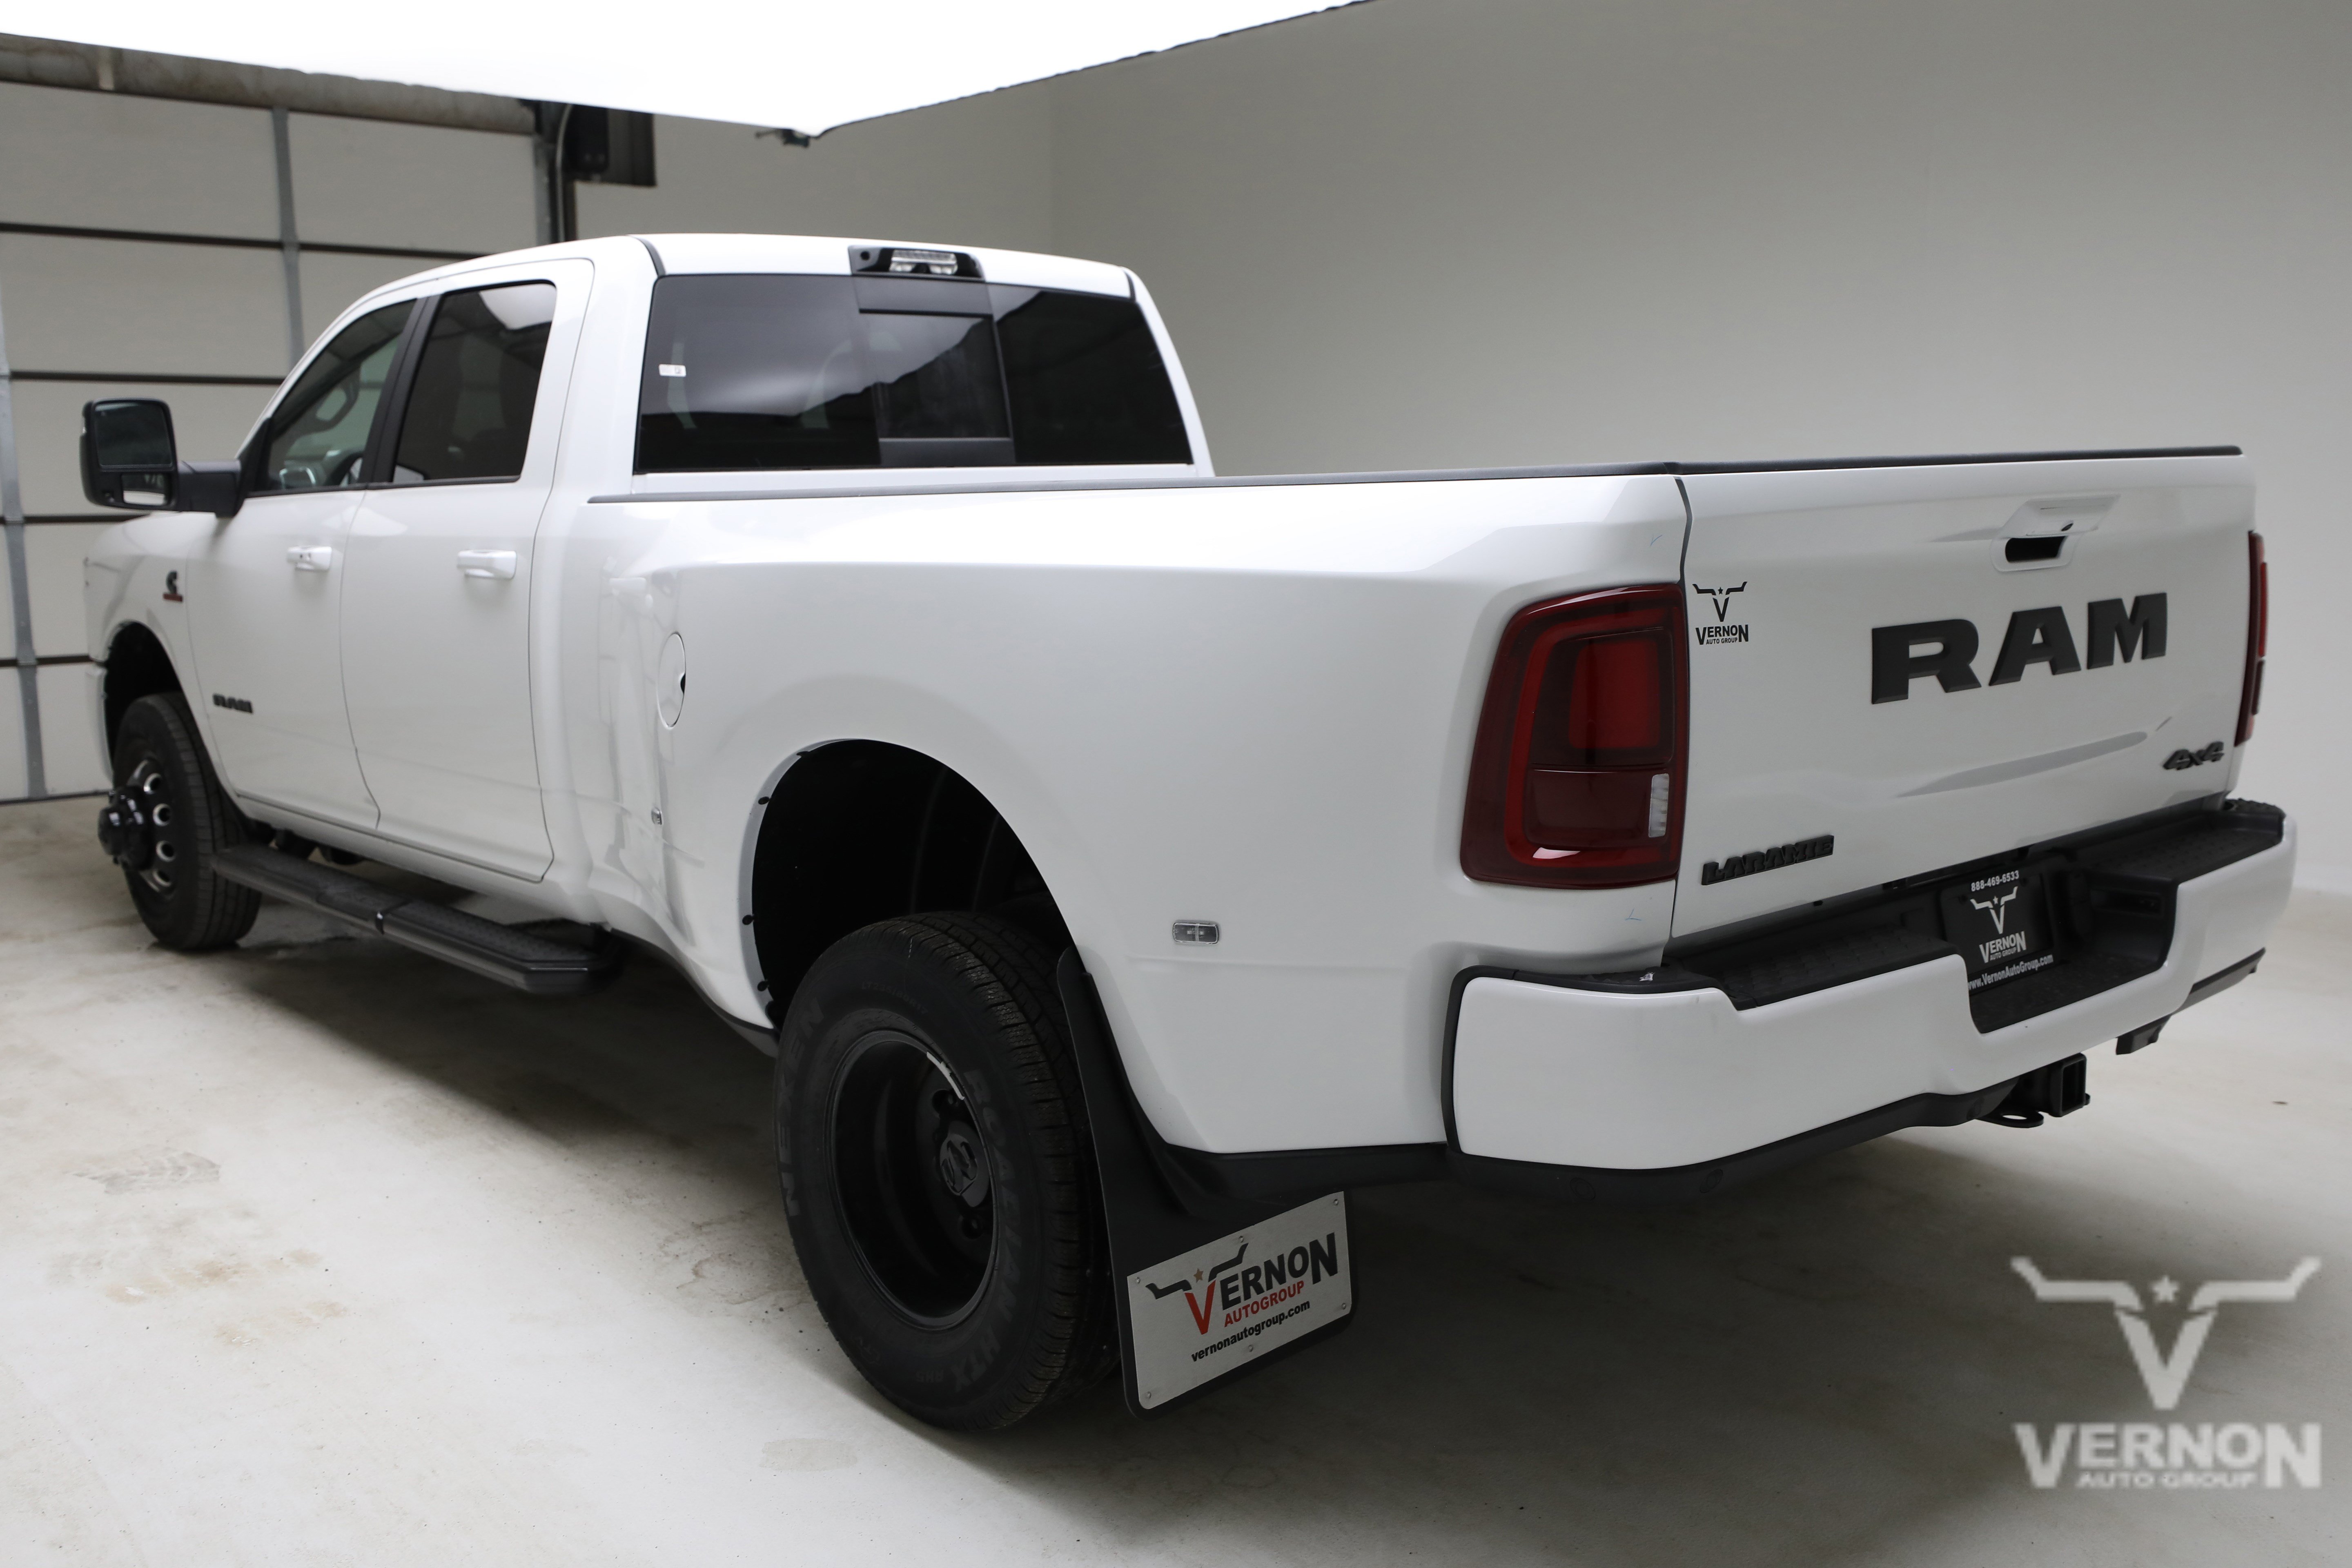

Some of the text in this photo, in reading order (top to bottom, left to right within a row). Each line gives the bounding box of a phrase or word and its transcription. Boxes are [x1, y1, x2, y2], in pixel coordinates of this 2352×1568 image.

[1695, 624, 1749, 645] VERNON
[1871, 592, 2168, 705] RAM
[1701, 835, 1835, 886] LARAMIE
[1971, 870, 2020, 892] 888-469-6533
[1979, 931, 2027, 963] VERNON
[1990, 947, 2017, 960] AUTO GROUP
[777, 997, 824, 1217] NEXEN
[963, 1069, 1022, 1323] ROADIAN
[1184, 1232, 1338, 1335] VERNON
[1224, 1280, 1305, 1328] AUTOGROUP
[950, 1324, 1001, 1393] HTX
[1191, 1300, 1310, 1362] vernonautogroup.com
